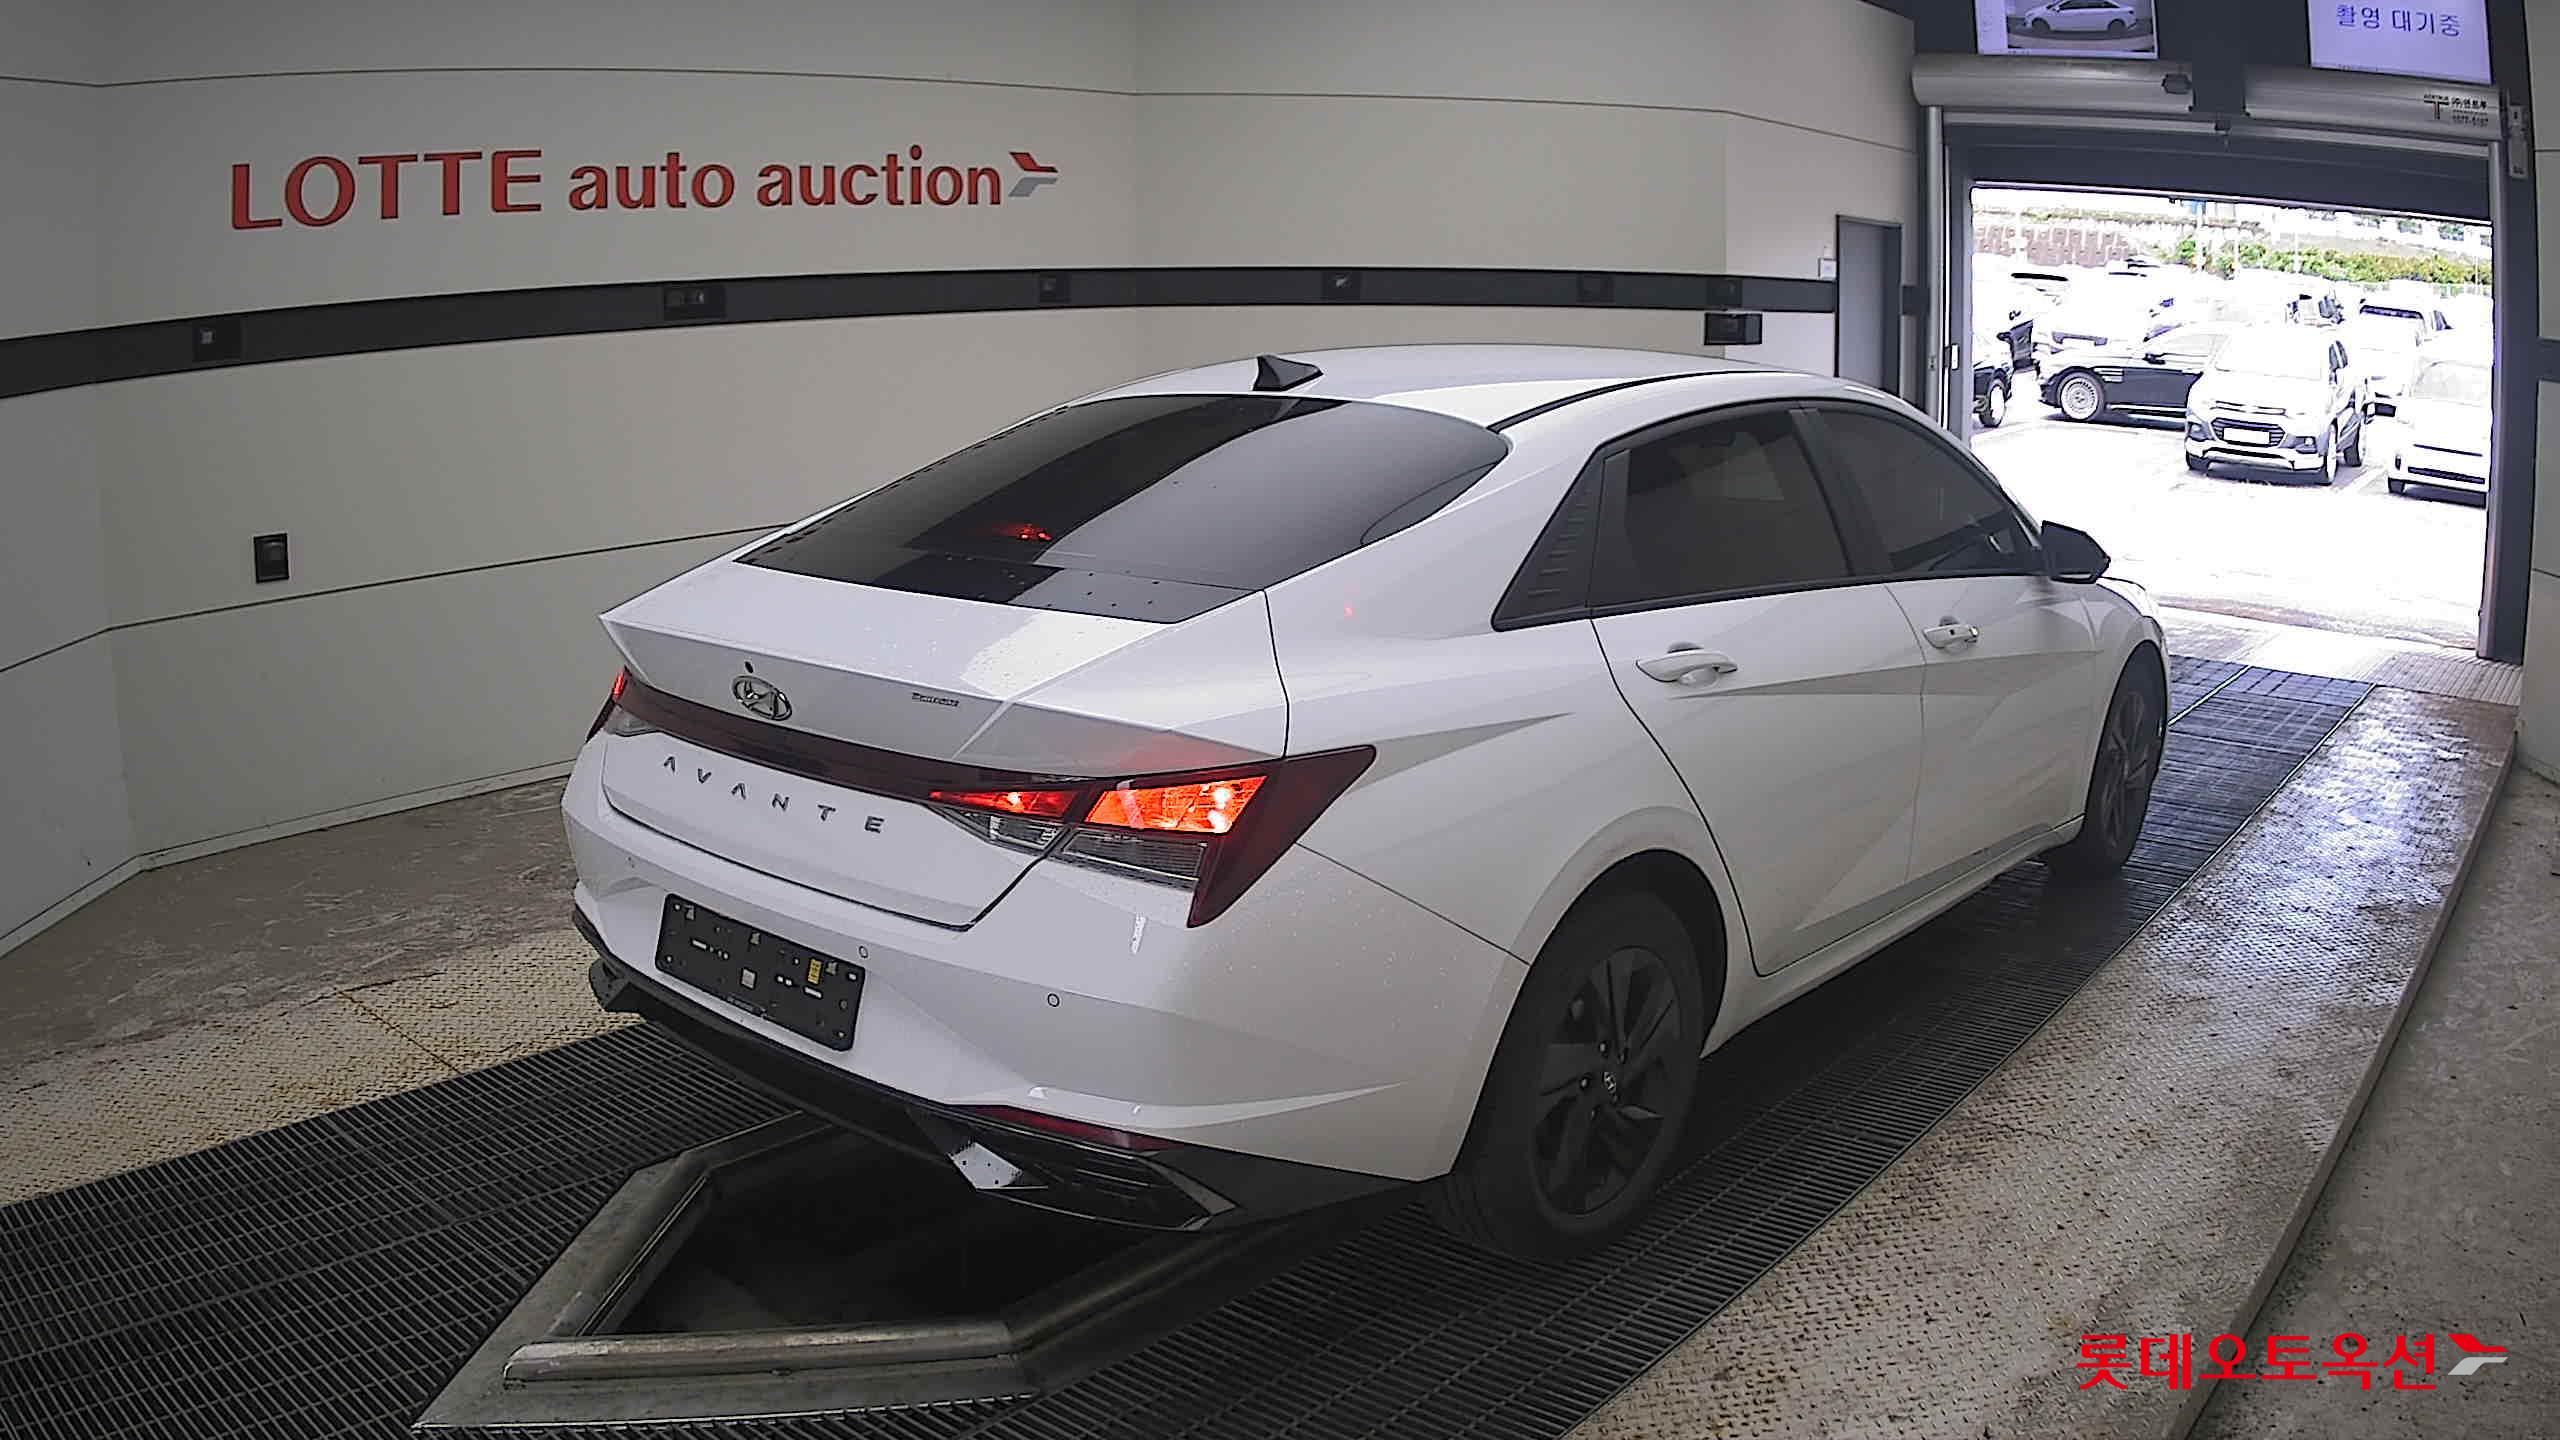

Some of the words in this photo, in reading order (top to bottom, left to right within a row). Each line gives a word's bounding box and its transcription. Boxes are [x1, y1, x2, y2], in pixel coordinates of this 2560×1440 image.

[2337, 4, 2380, 29] 촬영
[2392, 9, 2460, 37] 대기중
[231, 149, 542, 230] LOTTE
[568, 151, 736, 209] auto
[756, 143, 1001, 207] auction
[663, 755, 885, 835] AVANTE
